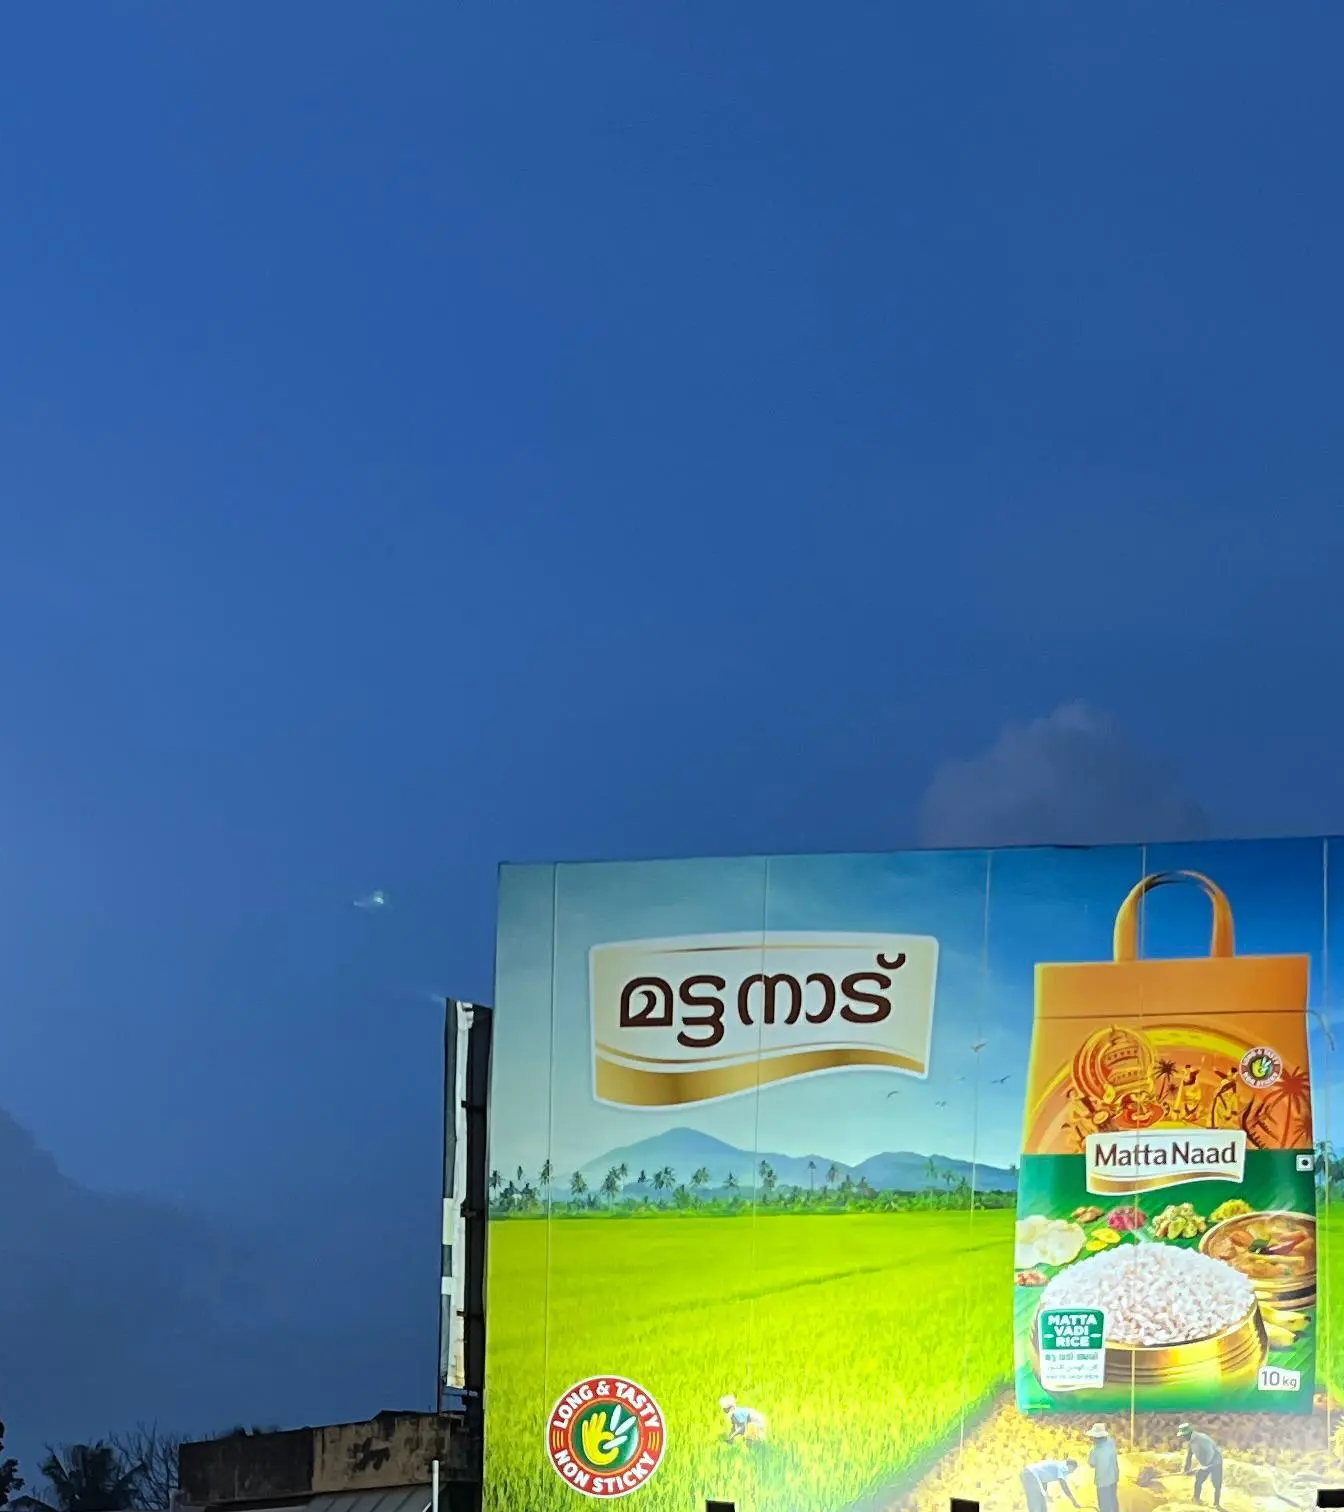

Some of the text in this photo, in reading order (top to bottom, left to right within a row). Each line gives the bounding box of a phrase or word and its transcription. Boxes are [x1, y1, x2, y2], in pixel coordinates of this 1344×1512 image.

[1047, 1313, 1098, 1326] MATTA
[1053, 1325, 1089, 1336] VADI
[1055, 1336, 1090, 1347] RICE
[1261, 1370, 1297, 1389] 10 kg
[552, 1380, 661, 1430] LONG & TASTY
[553, 1449, 656, 1494] NON STICKY
